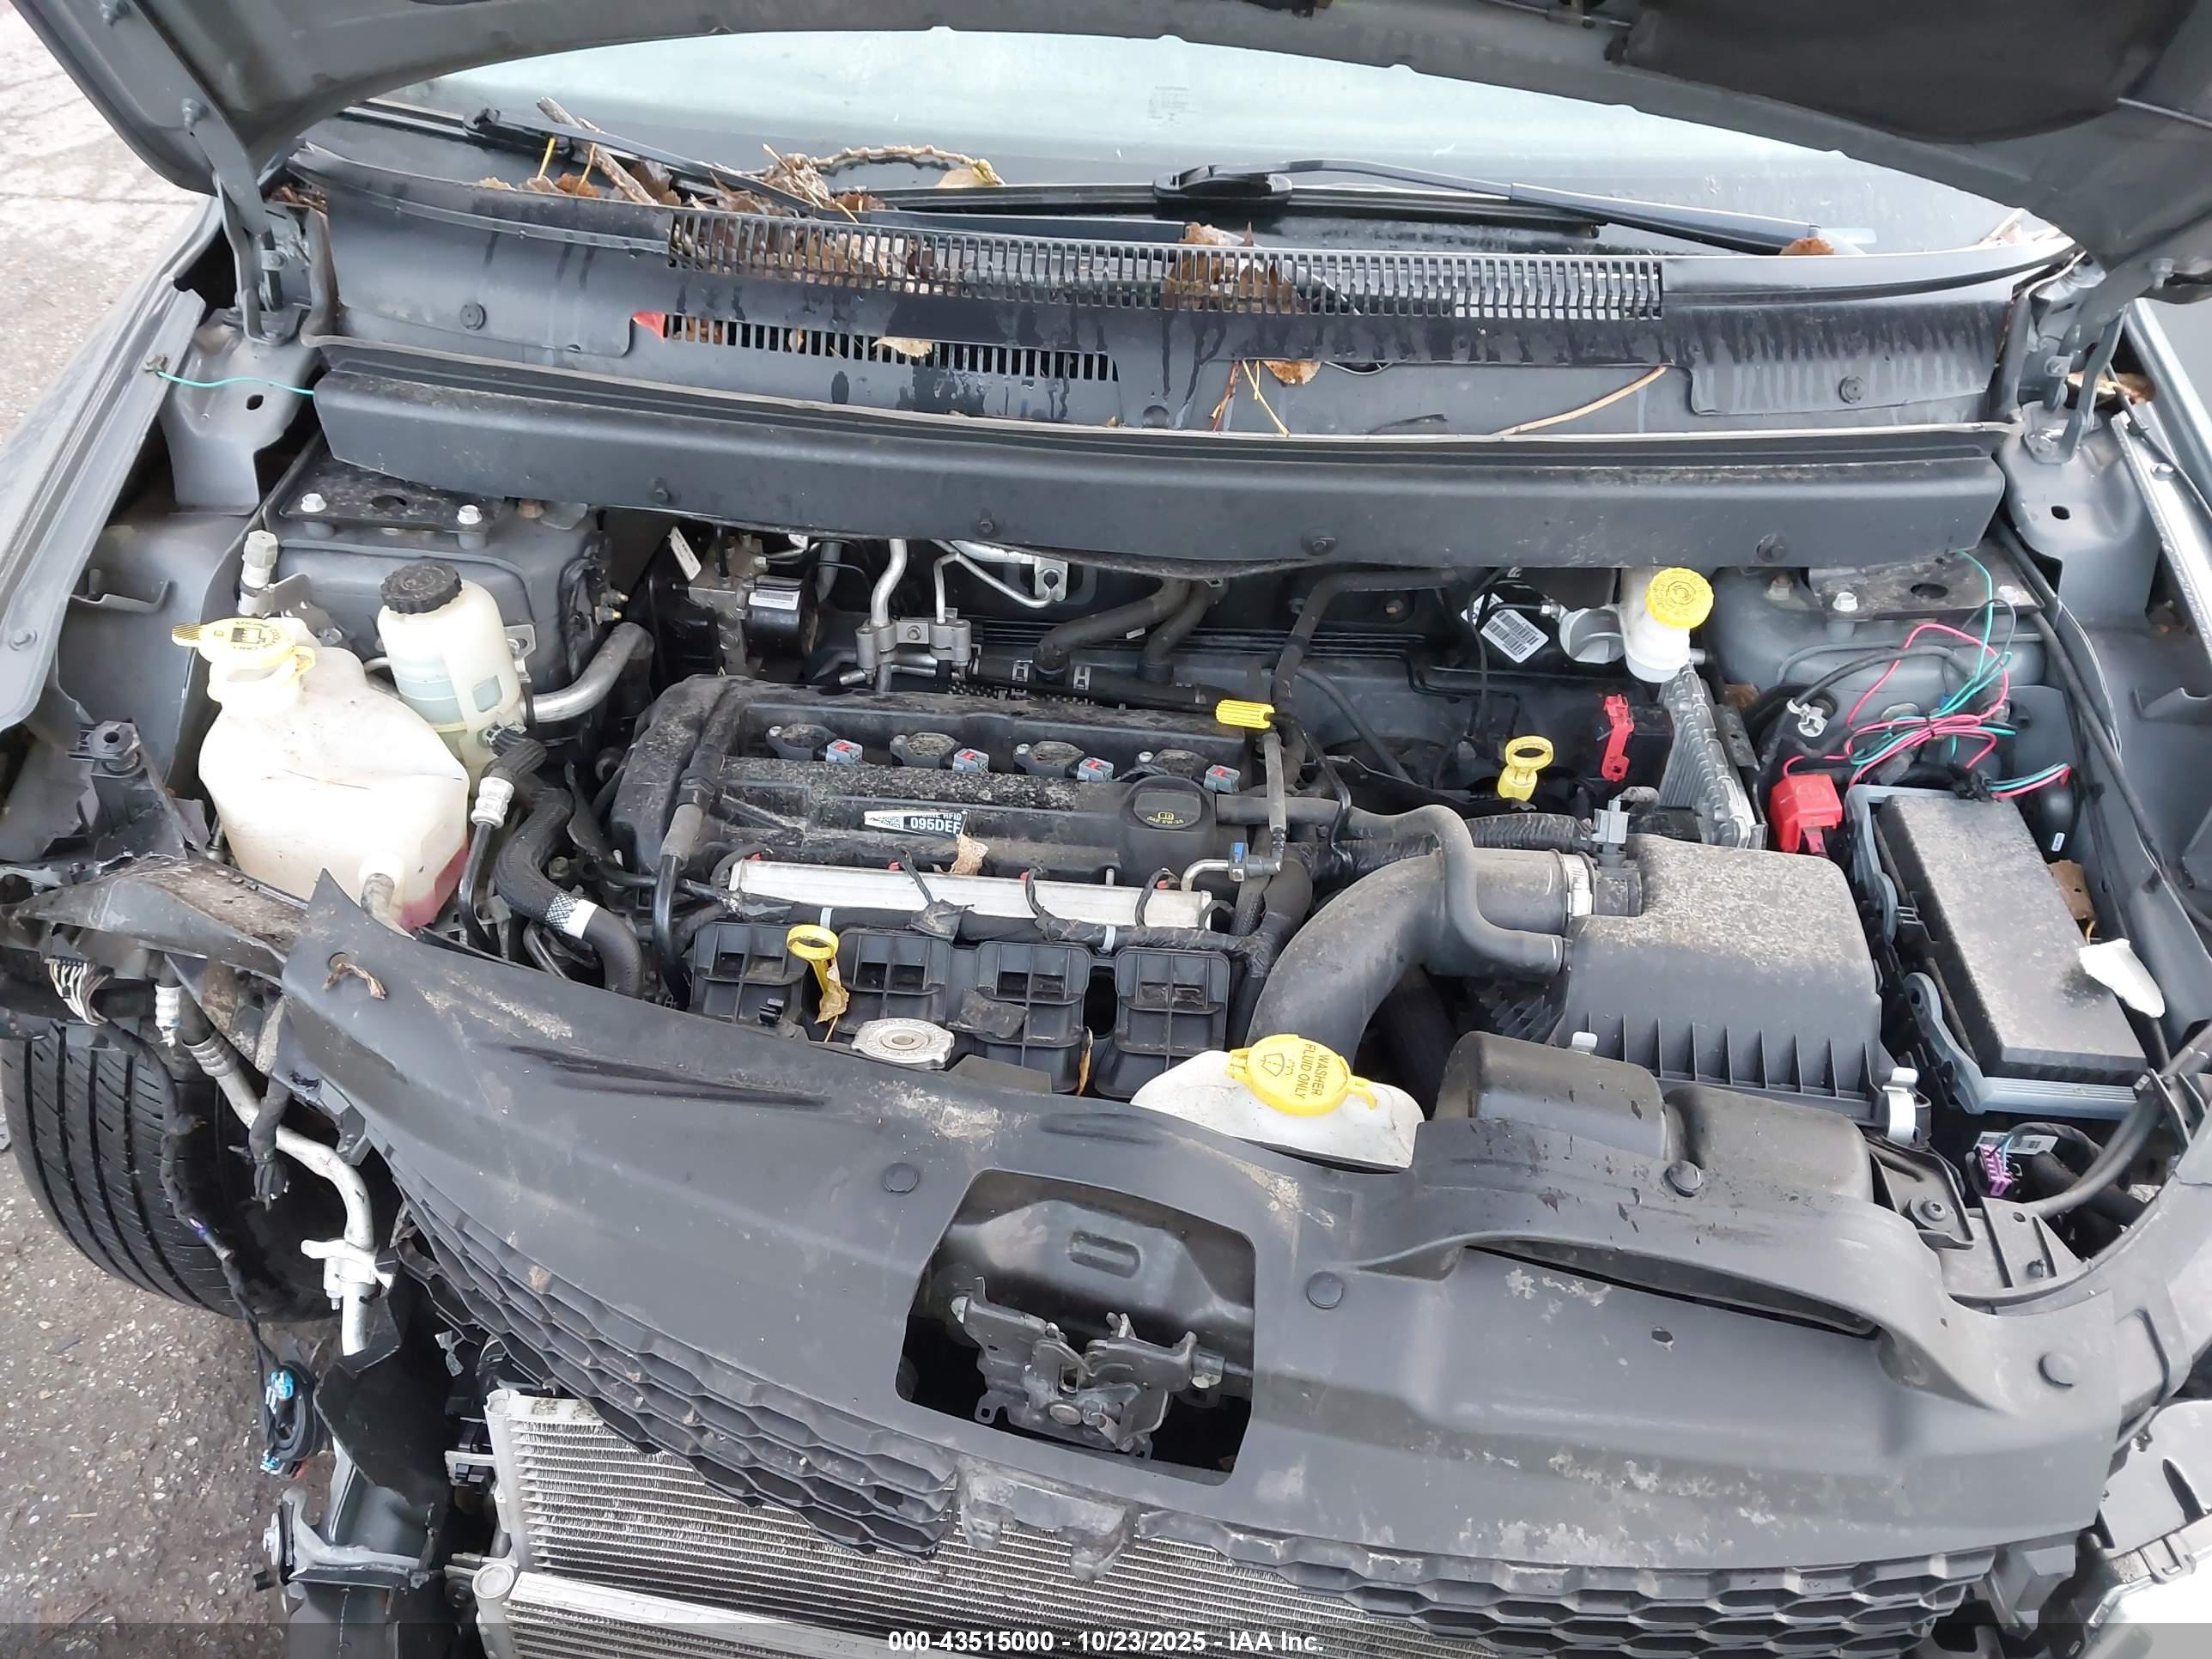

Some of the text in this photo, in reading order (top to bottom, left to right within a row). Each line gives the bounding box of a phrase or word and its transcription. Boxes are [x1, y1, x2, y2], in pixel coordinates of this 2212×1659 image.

[910, 817, 962, 835] 095DEF
[1295, 1043, 1316, 1099] FLUID ONLY
[1311, 1054, 1330, 1097] WASHER
